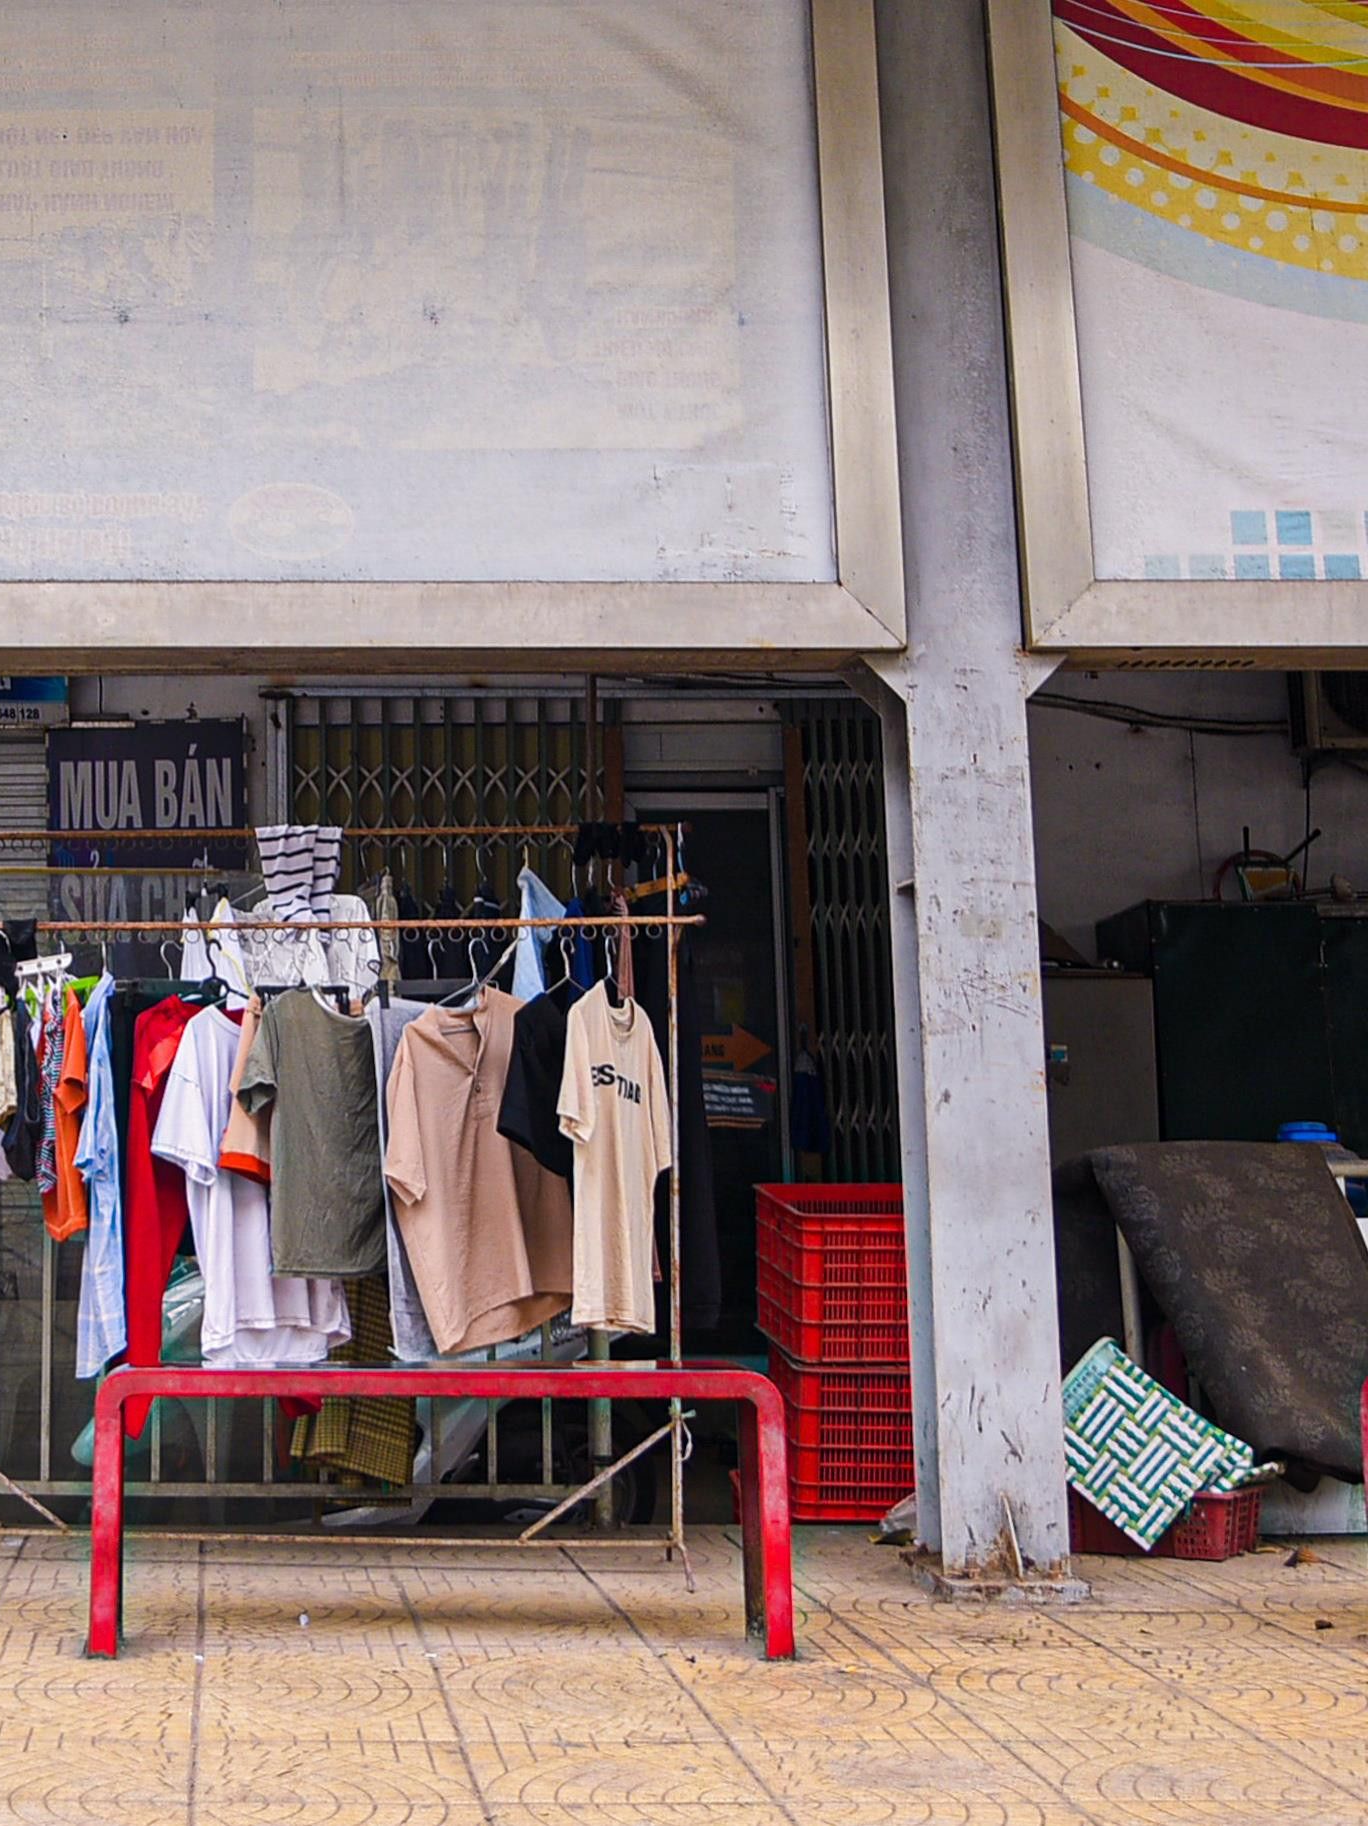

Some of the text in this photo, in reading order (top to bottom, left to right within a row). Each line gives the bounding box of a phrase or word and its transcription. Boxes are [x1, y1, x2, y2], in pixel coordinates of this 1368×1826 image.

[20, 707, 40, 720] 128
[59, 743, 233, 830] MUA BÁN
